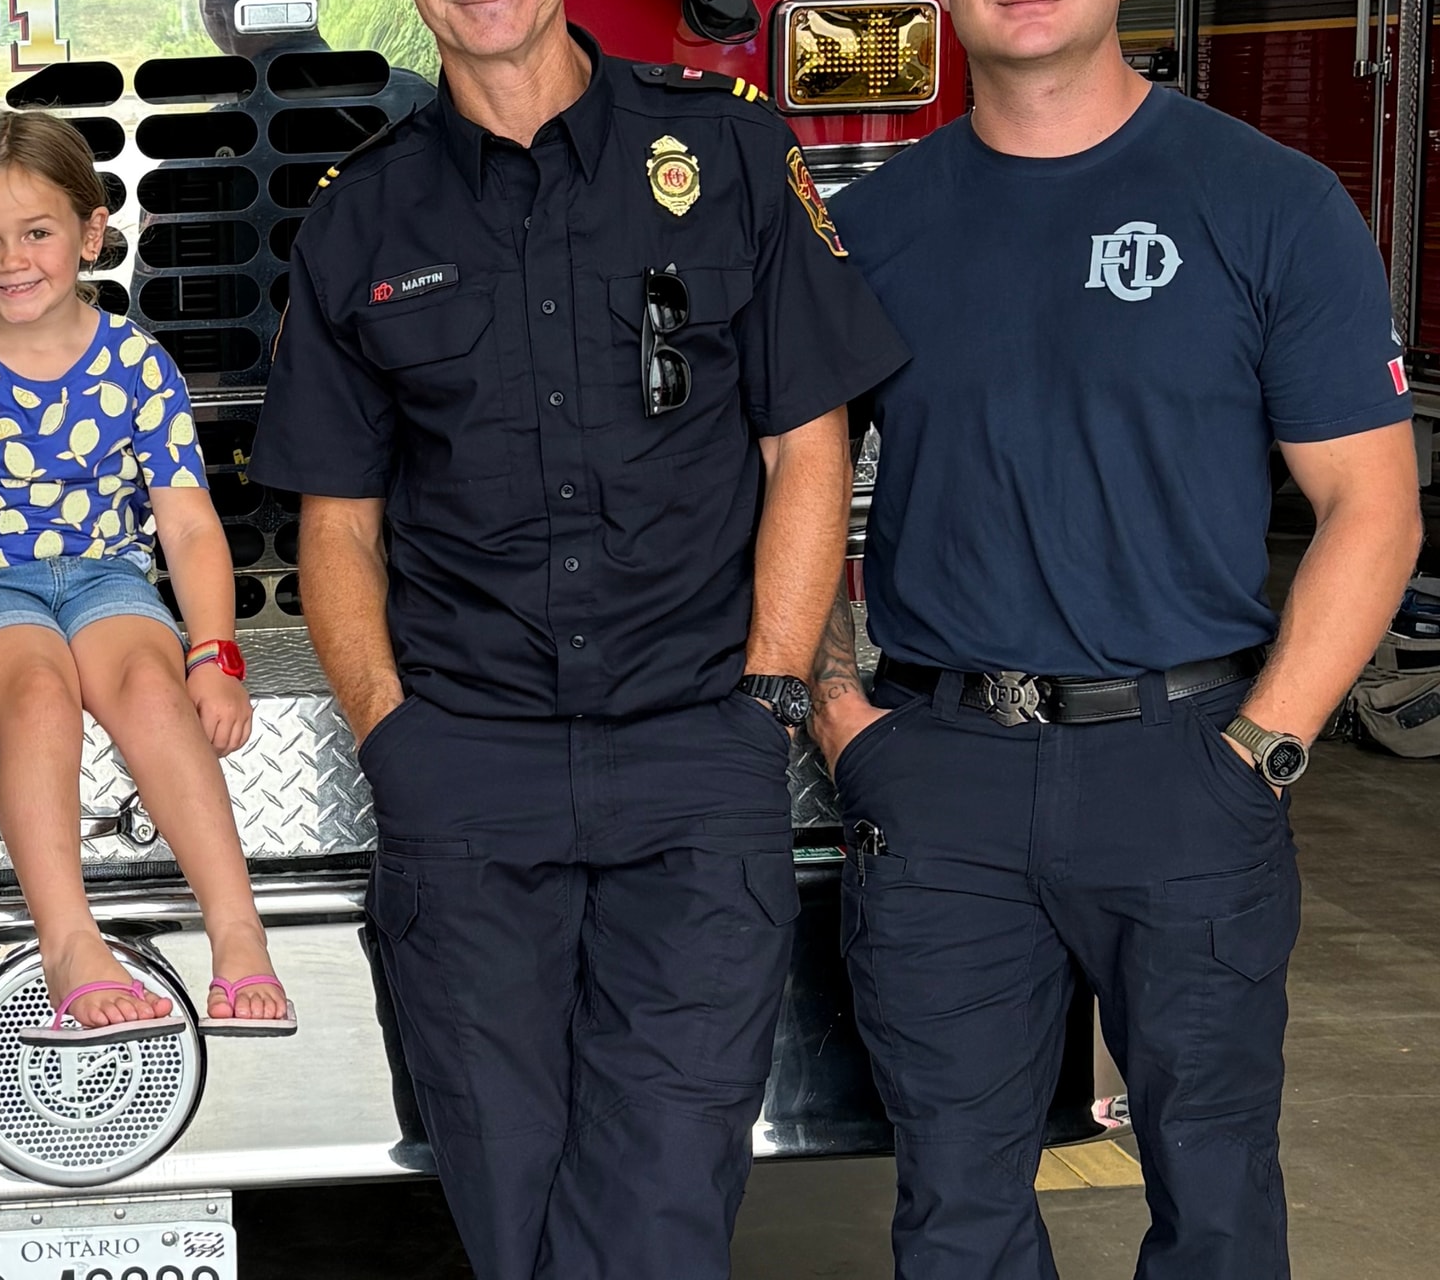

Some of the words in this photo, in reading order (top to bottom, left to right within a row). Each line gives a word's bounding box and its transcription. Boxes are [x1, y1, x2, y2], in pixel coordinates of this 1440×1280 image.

[401, 272, 443, 292] MARTIN
[997, 686, 1021, 705] FD
[21, 1237, 140, 1263] ONTARIO
